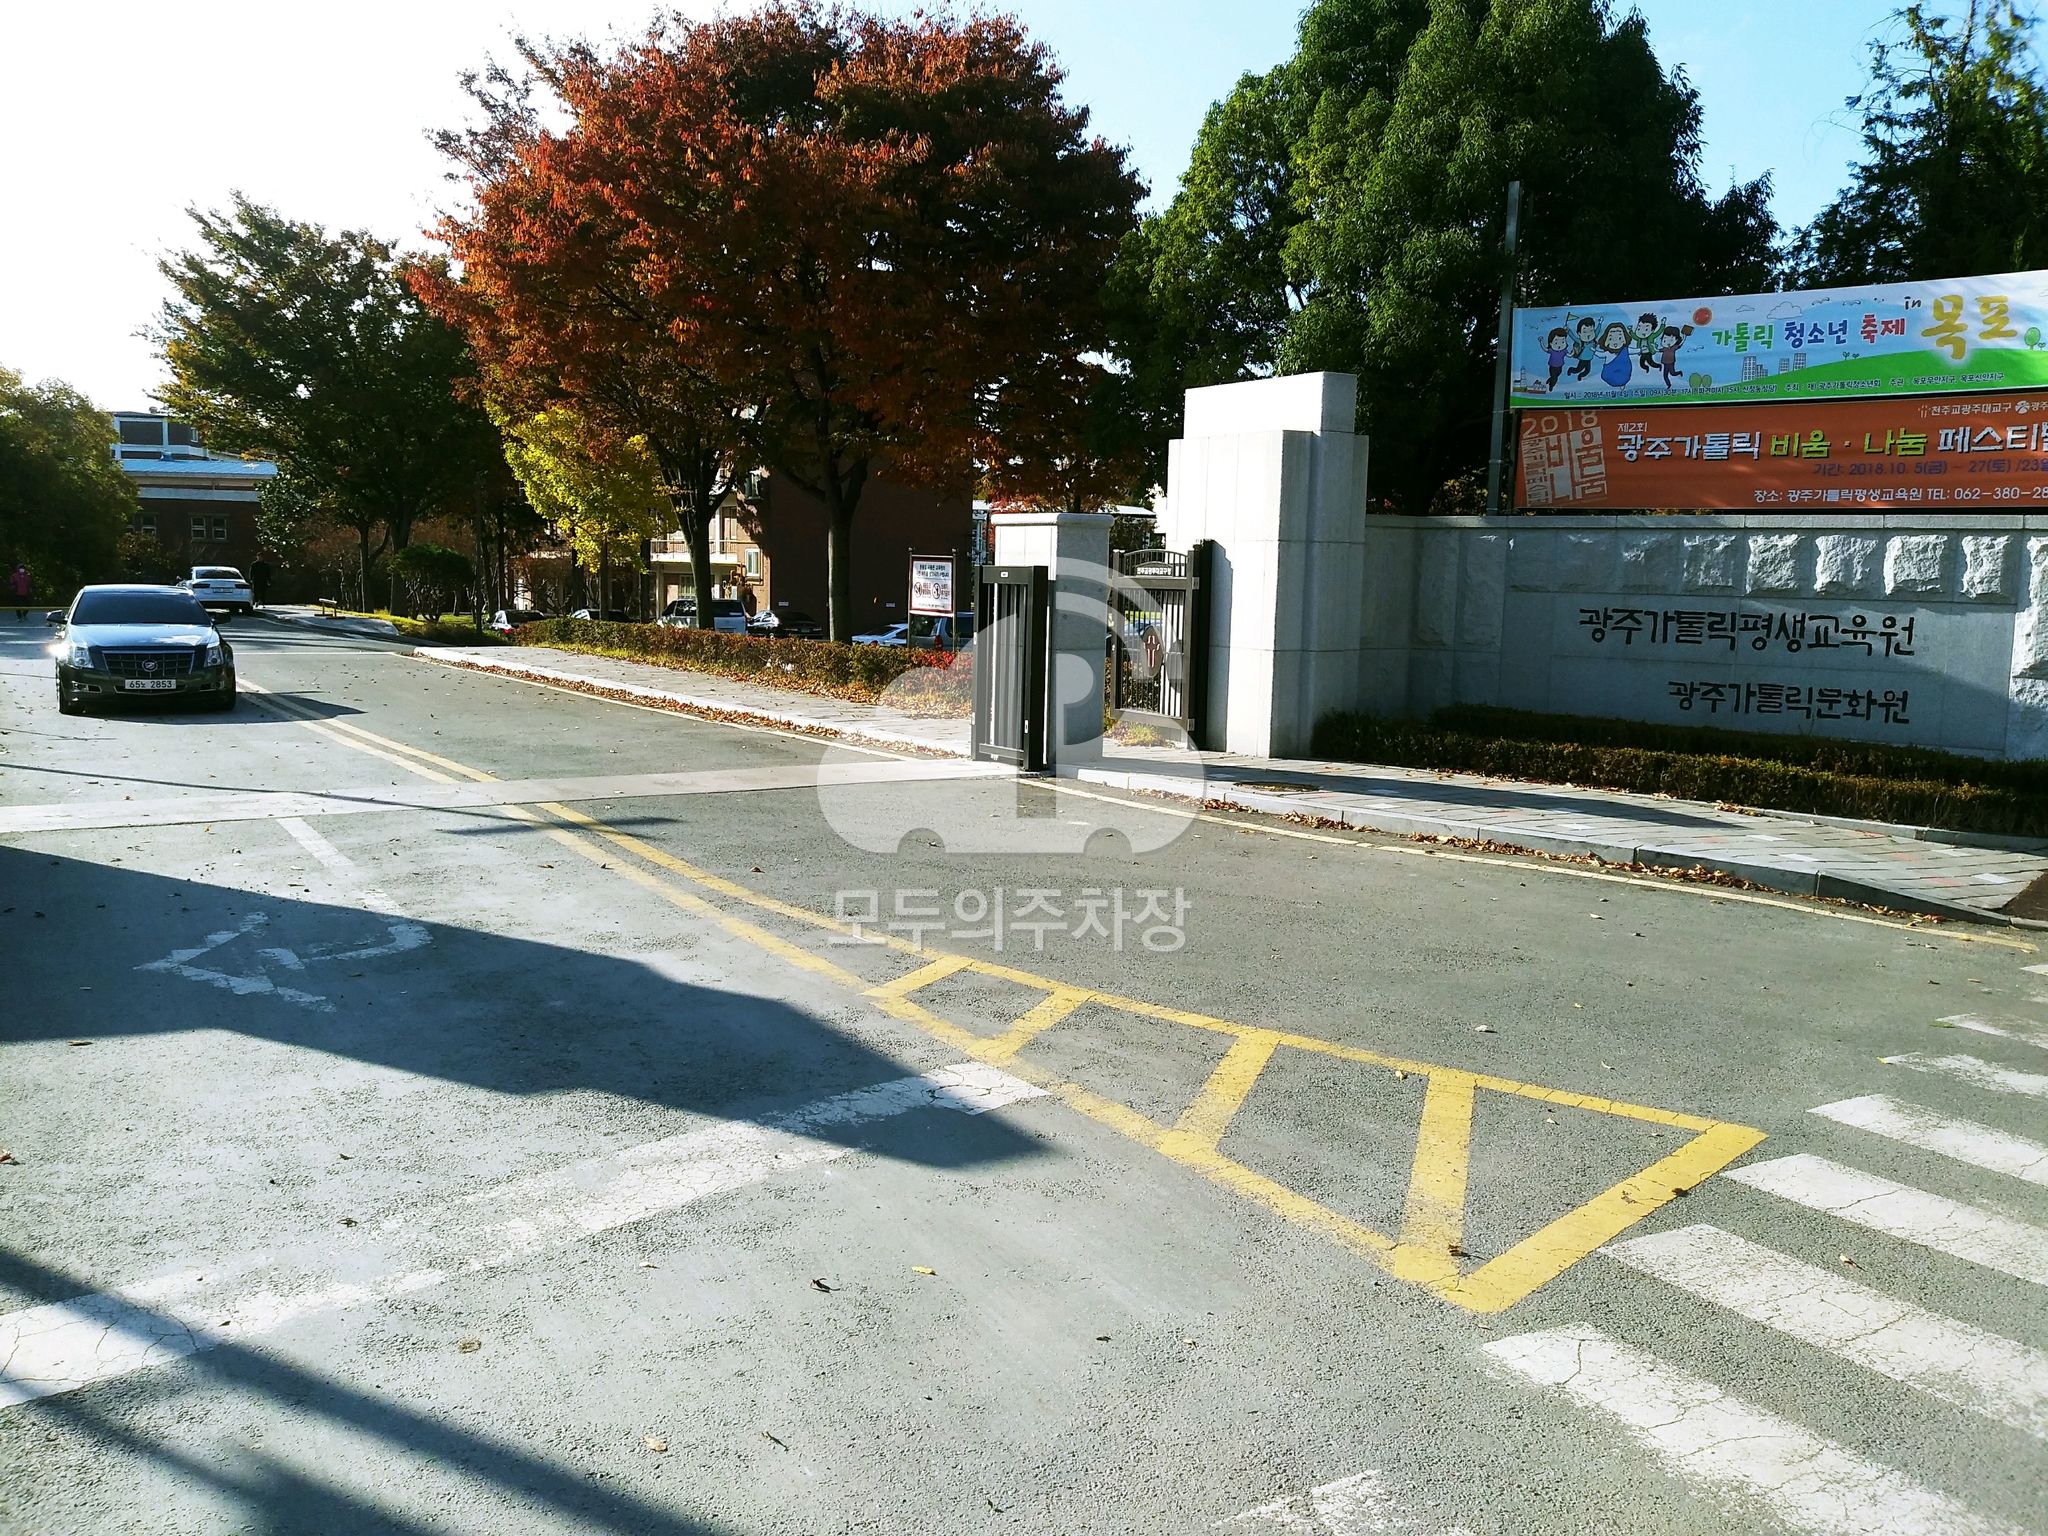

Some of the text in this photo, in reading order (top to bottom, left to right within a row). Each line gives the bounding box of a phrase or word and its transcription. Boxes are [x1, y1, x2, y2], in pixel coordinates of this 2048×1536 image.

[1904, 296, 1922, 311] in
[1711, 313, 1906, 352] 가톨릭 청소년 축제
[1921, 293, 2018, 360] 목포
[1931, 402, 2012, 415] 천주교광주대교구
[1521, 410, 1598, 438] 2018
[1617, 422, 1648, 433] 제2회
[1617, 432, 1761, 462] 광주가톨릭
[1770, 429, 1831, 459] 비움
[1863, 427, 1928, 456] 나눔
[1938, 422, 2048, 453] 페스티
[1754, 489, 1783, 503] 장소:
[1787, 488, 1922, 502] 광주가톨릭평생교육원
[1928, 489, 1950, 499] TEL:
[1579, 607, 1915, 657] 광주가톨릭평생교육원
[150, 680, 172, 688] 2853
[1668, 681, 1910, 724] 광주가톨릭문화원
